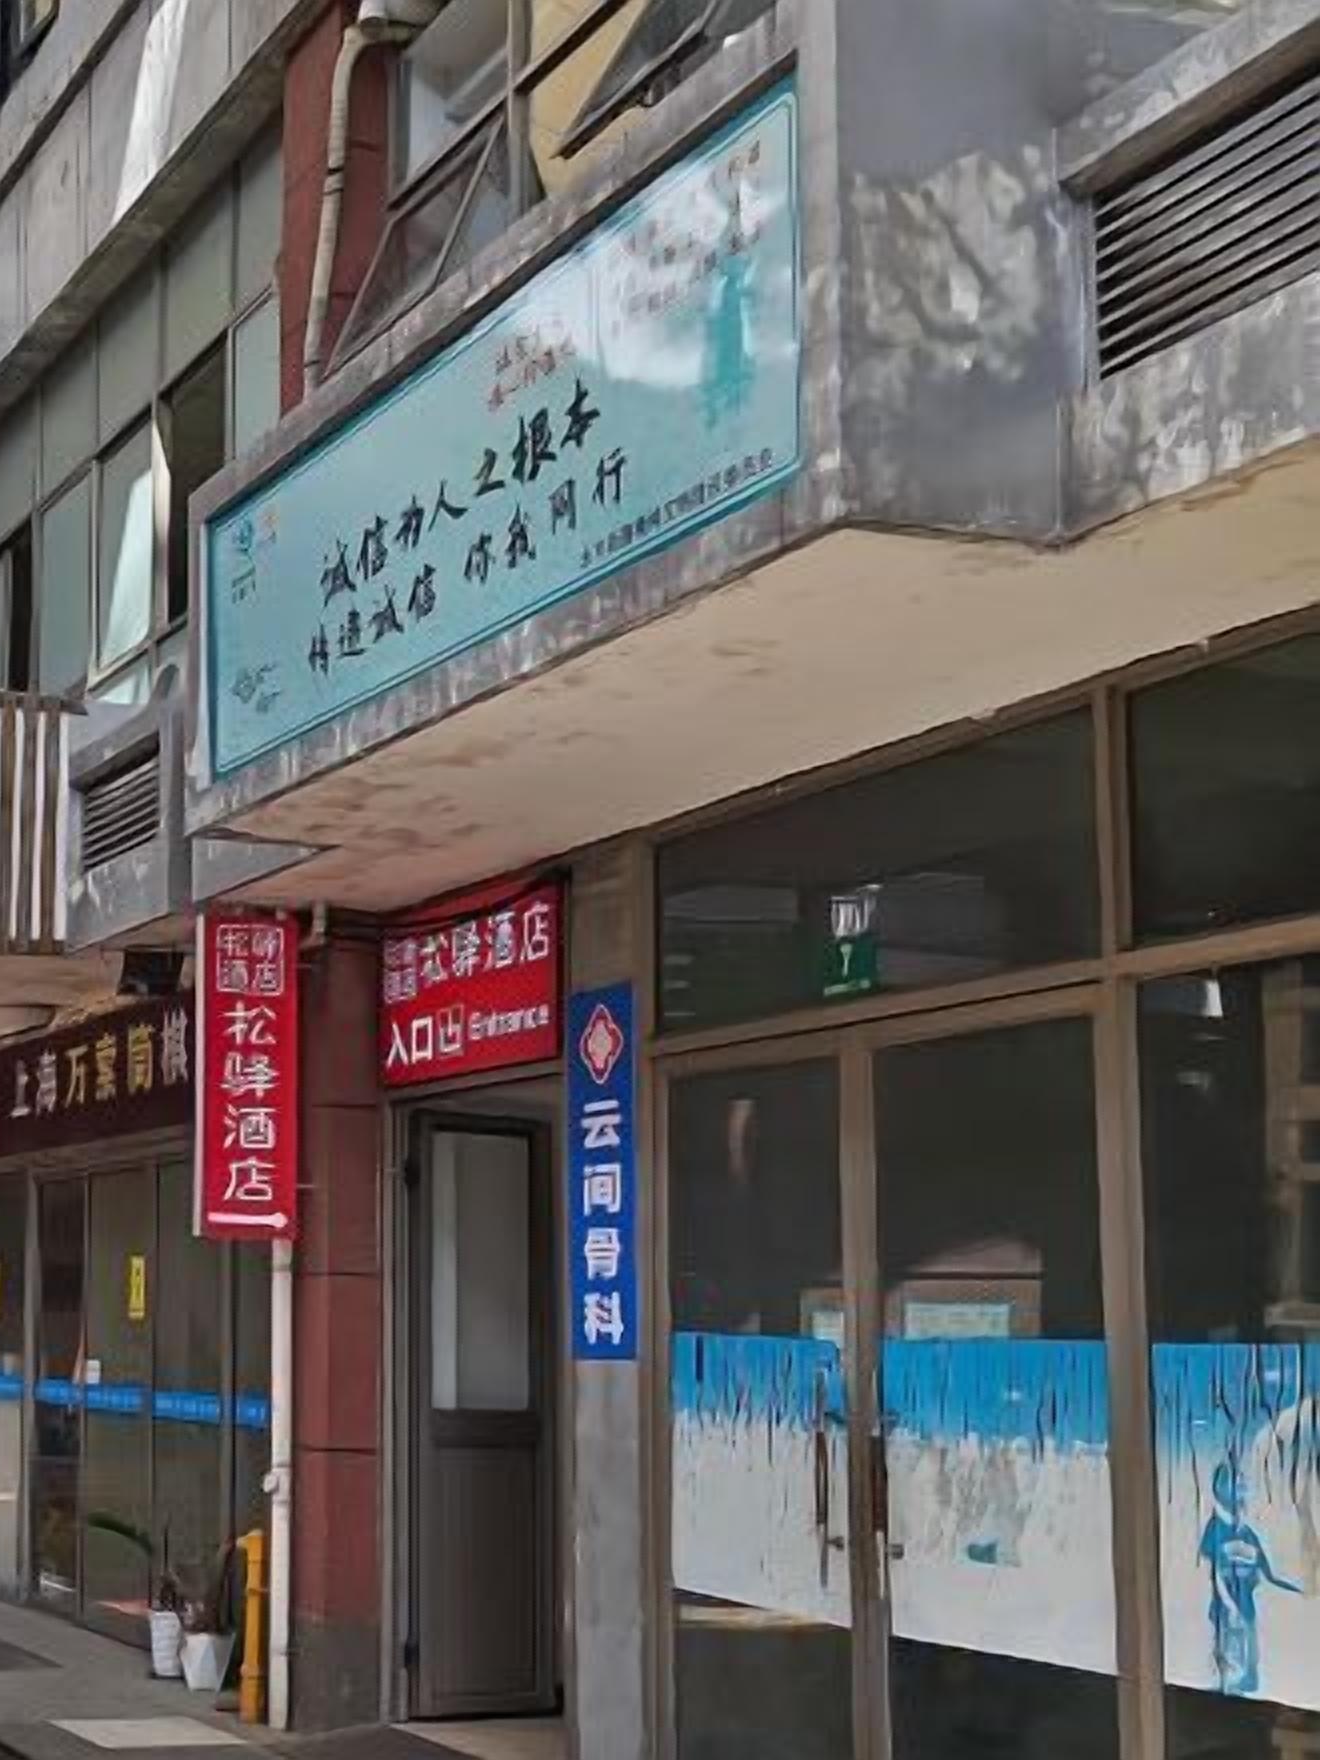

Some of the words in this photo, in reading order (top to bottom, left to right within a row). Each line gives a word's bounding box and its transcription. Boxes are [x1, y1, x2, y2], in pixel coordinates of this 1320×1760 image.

[220, 1001, 280, 1201] 松驿酒店
[581, 1099, 624, 1345] 云间骨科
